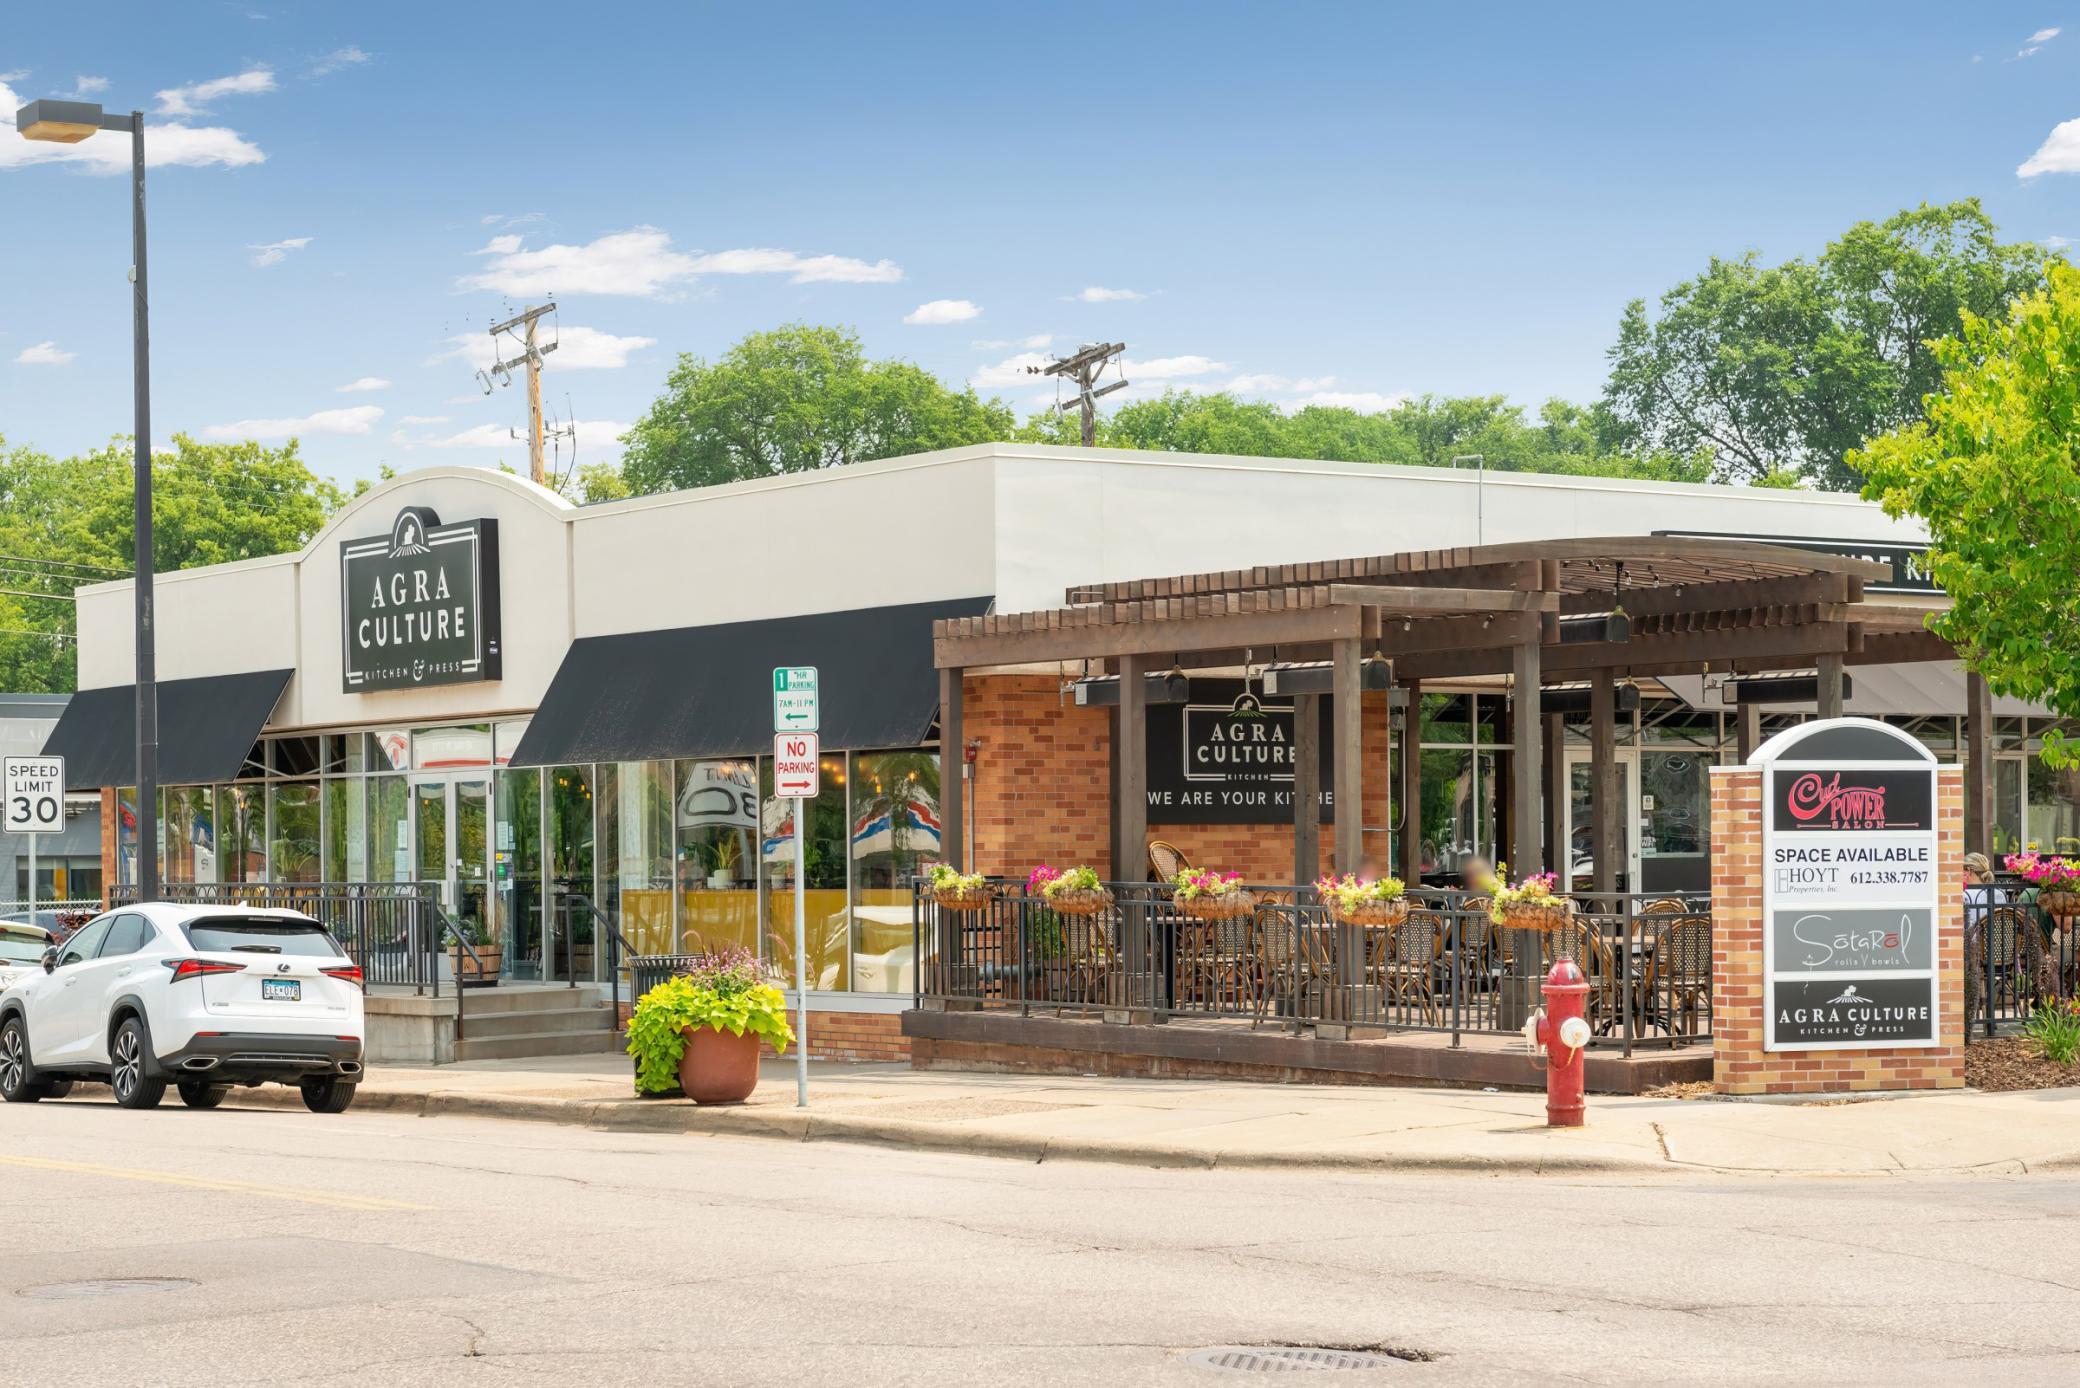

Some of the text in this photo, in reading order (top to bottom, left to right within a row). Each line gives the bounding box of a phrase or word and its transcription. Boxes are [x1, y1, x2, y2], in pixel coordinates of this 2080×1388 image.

[371, 566, 450, 608] AGRA
[358, 606, 465, 648] CULTURE
[365, 659, 461, 682] KITCHEN & PRESS
[1210, 722, 1286, 742] AGRA
[787, 741, 806, 757] NO
[1197, 745, 1295, 764] CULTURE
[9, 765, 59, 777] SPEED
[778, 761, 815, 774] PARKING
[1227, 773, 1269, 781] KITCHEN
[15, 781, 53, 792] LIMIT
[1147, 791, 1172, 805] WE
[1181, 791, 1213, 805] ARE
[1221, 791, 1266, 805] YOUR
[1830, 790, 1885, 820] POWER
[11, 796, 58, 823] 30
[1832, 821, 1885, 829] SALON
[1774, 847, 1929, 863] SPACE AVAILABLE
[1789, 867, 1929, 885] HOYT 612.338.7787
[1779, 1006, 1928, 1024] AGRA CULTURE
[1800, 1027, 1849, 1035] KITCHEN
[1854, 1023, 1867, 1037] &
